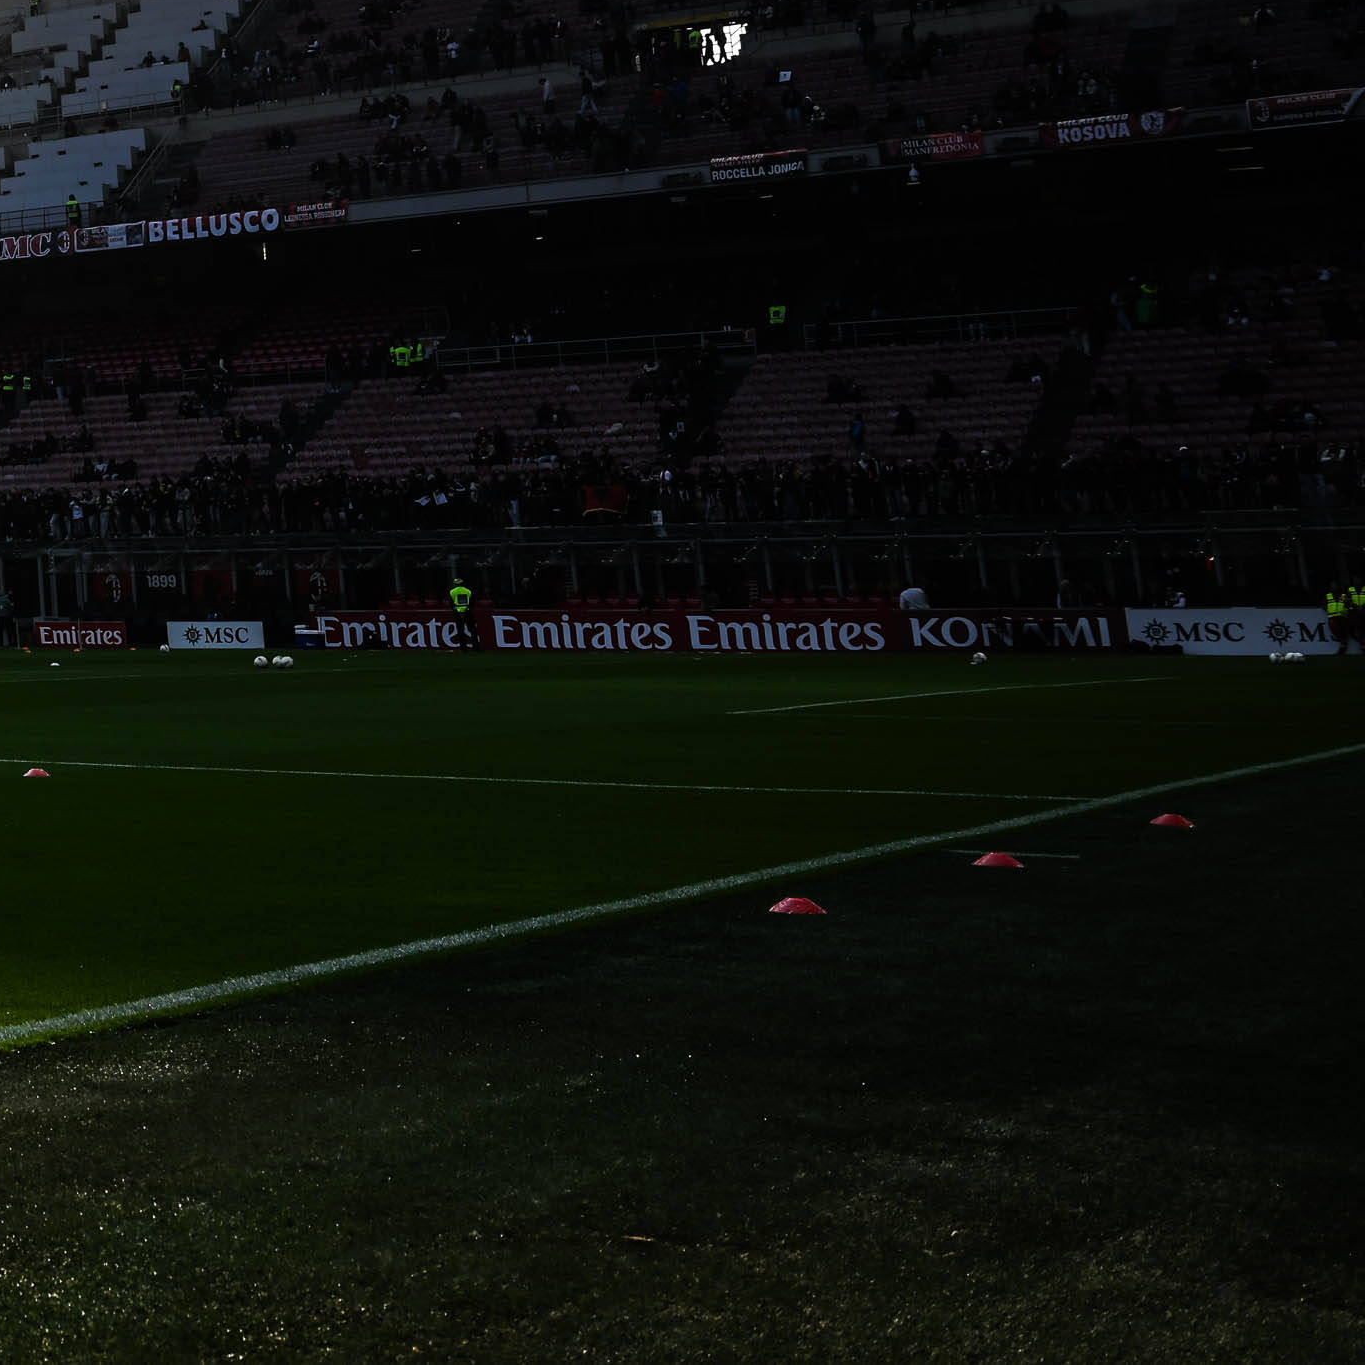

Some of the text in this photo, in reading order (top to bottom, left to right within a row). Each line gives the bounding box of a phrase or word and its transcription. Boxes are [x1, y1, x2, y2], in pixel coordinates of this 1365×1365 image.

[903, 135, 964, 149] MILAN CLUB
[1057, 121, 1132, 145] KOSOVA
[711, 165, 766, 181] ROCCELLA
[767, 160, 805, 176] JONICA
[148, 208, 280, 243] BELLUSCO
[147, 574, 177, 588] 1899
[38, 625, 123, 646] Emirates
[204, 626, 249, 644] MSC
[492, 613, 673, 650] Emirates
[685, 613, 886, 651] Emirates
[1173, 621, 1245, 642] MSC
